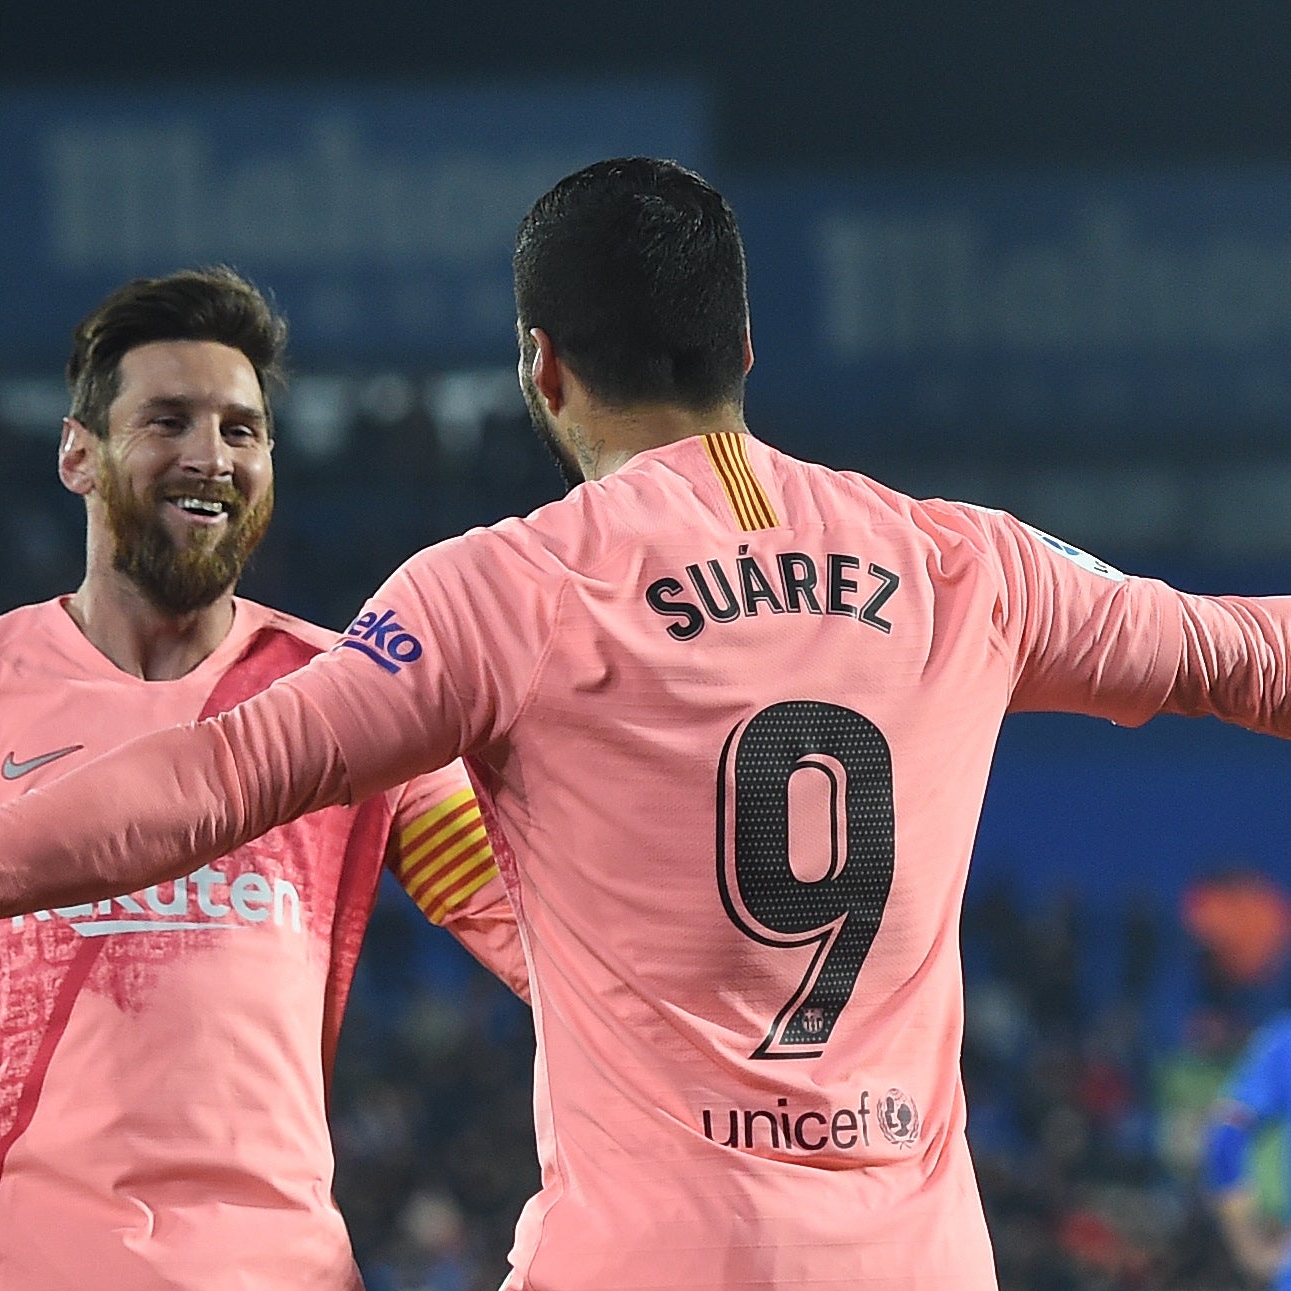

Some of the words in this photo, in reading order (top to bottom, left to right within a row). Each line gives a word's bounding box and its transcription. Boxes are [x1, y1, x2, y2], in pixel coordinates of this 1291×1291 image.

[645, 544, 901, 642] SUÁREZ
[348, 609, 423, 663] eko
[11, 864, 301, 935] uten
[716, 699, 896, 1061] 9
[701, 1090, 870, 1150] unicef
